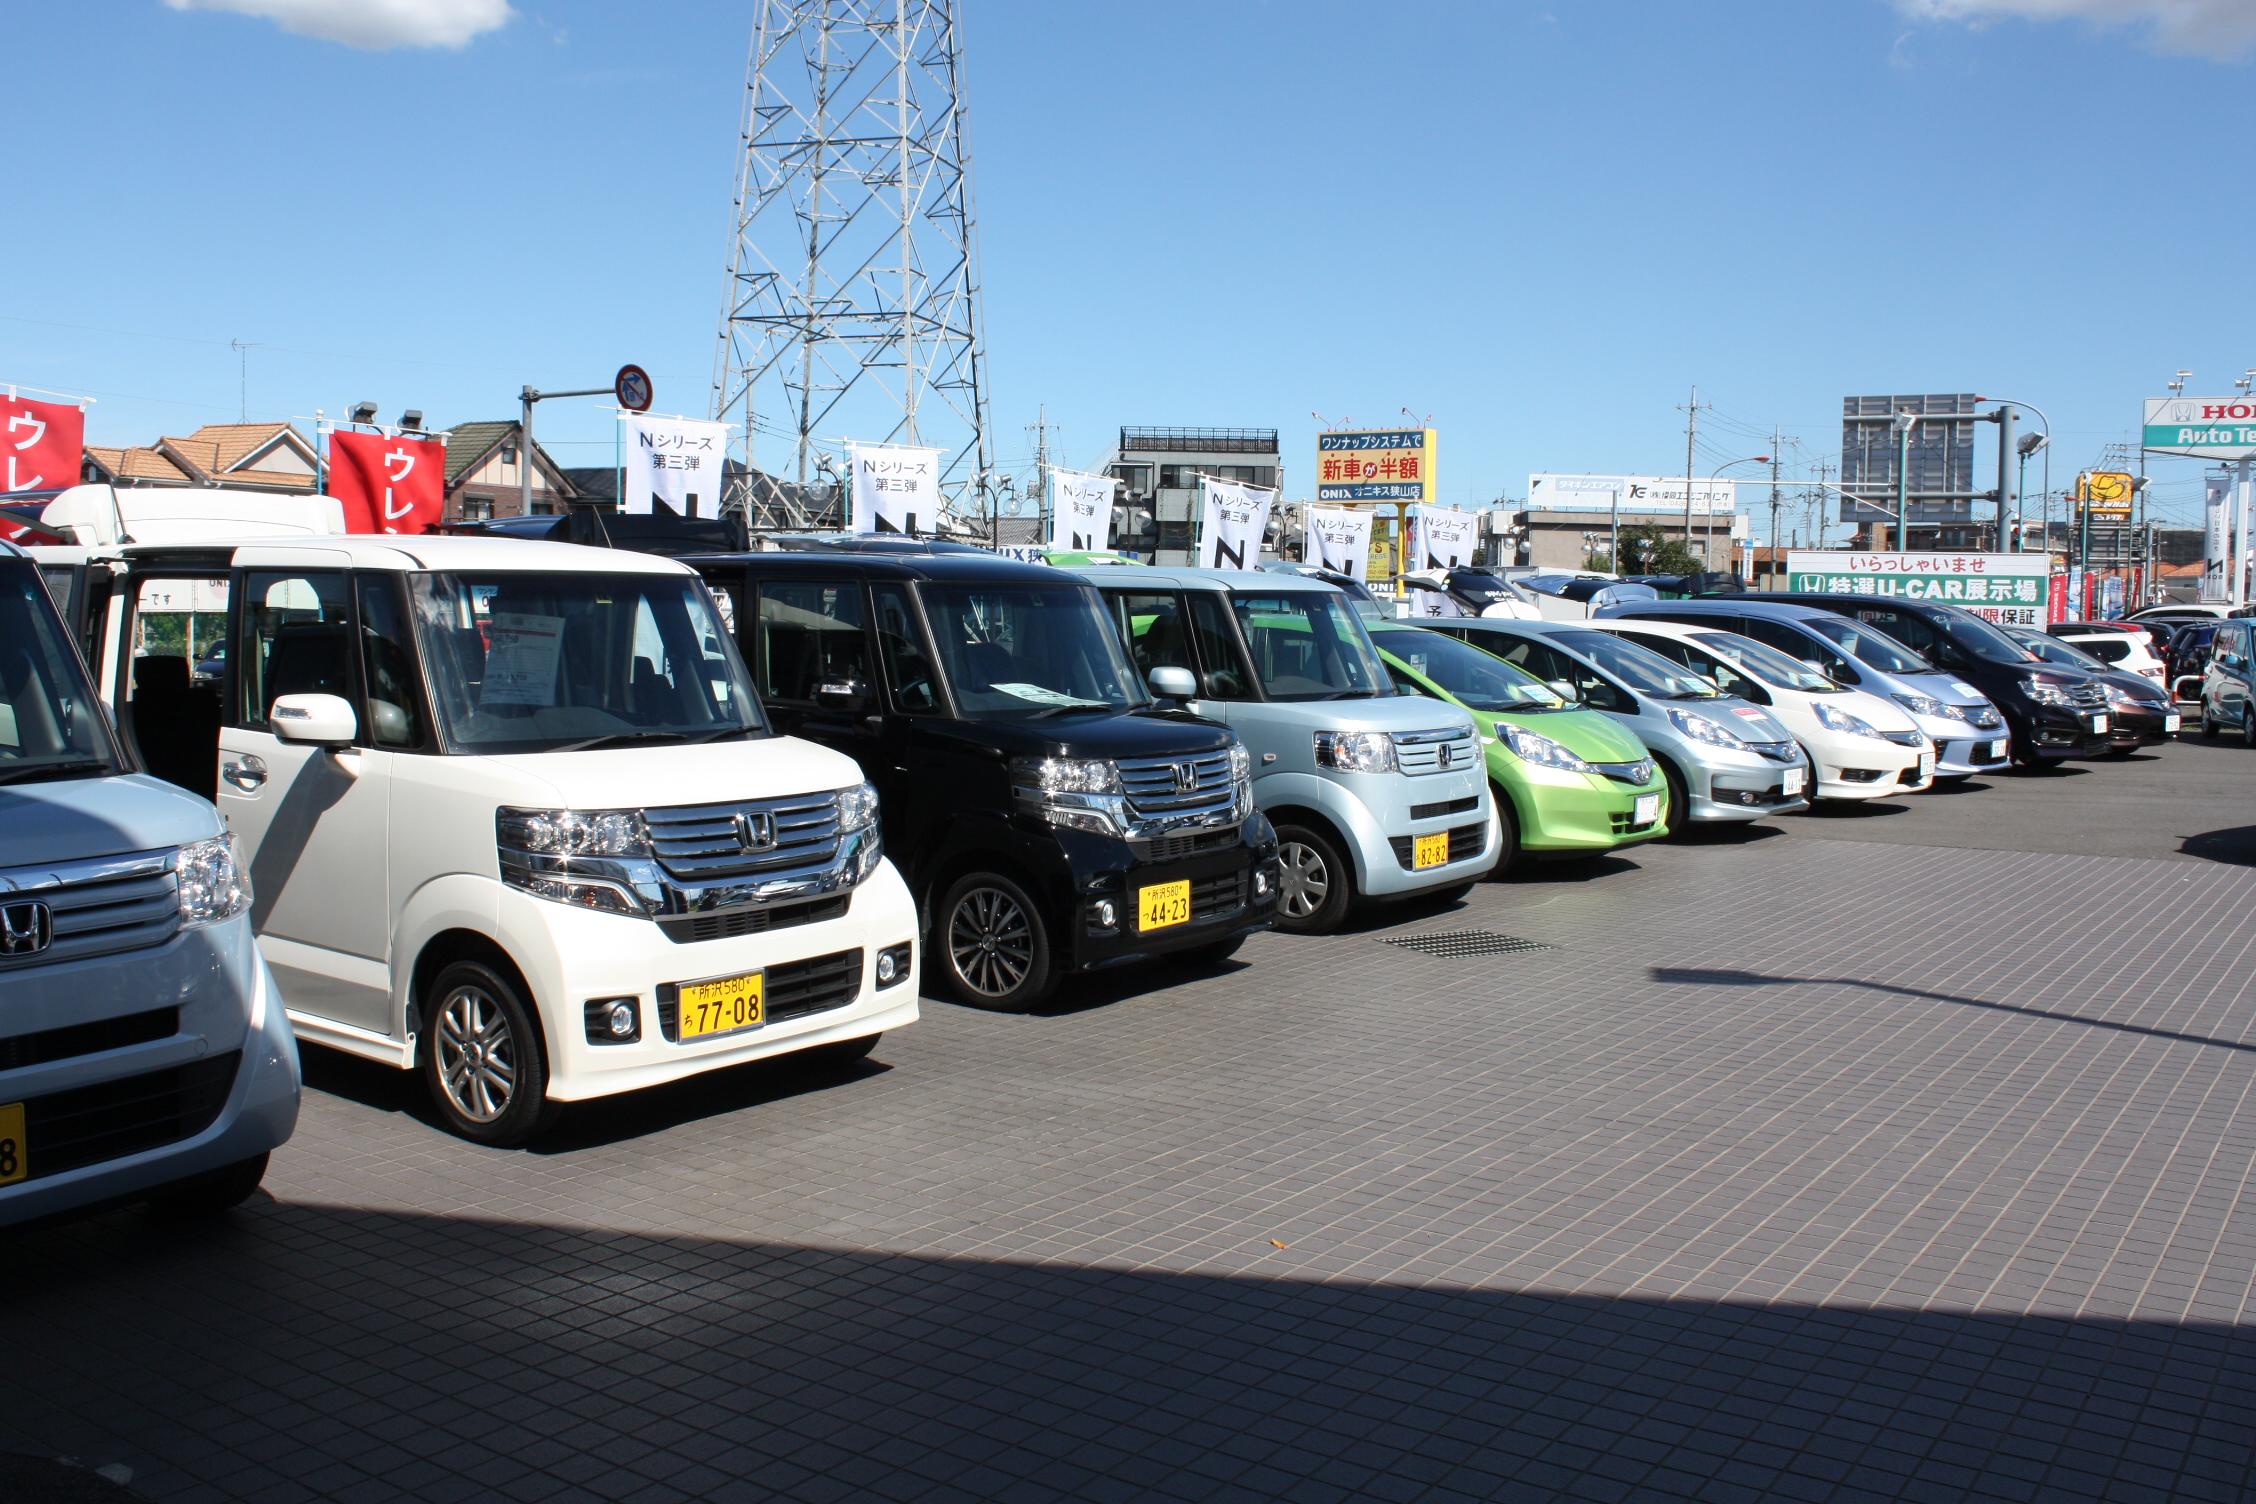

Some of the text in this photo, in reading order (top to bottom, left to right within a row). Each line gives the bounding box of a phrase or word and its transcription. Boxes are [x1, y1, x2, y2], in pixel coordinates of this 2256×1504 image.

[2202, 405, 2256, 419] HO
[640, 432, 715, 451] Nシリーズ
[1322, 434, 1421, 450] ワンナップシステムで
[2177, 428, 2233, 444] Auto
[653, 454, 700, 471] 第三弾
[864, 460, 928, 475] Nシリーズ
[1323, 457, 1419, 480] 新車が半額
[384, 447, 415, 534] ウレ
[875, 478, 918, 493] 第三弾
[1063, 484, 1107, 502] Nシリーズ
[1320, 485, 1421, 499] ONIX オニキス狭山店
[1072, 501, 1096, 518] 第三弾
[1213, 492, 1263, 511] Nシリーズ
[1219, 509, 1250, 524] 第三弾
[1424, 516, 1470, 531] Nシリーズ
[1316, 518, 1365, 533] Nシリーズ
[1324, 532, 1355, 546] 第三弾
[1431, 530, 1461, 542] 第三弾
[1213, 535, 1245, 571] N
[1850, 555, 1986, 573] いらっしゃいませ
[1368, 583, 1397, 592] ONI
[1828, 577, 2037, 602] 特選U-CAR展示場
[1421, 845, 1446, 865] 82-82
[1151, 898, 1187, 925] 44-23
[698, 977, 745, 1000] 所沢580
[684, 994, 759, 1033] ち 77-08
[0, 1137, 17, 1176] 8
